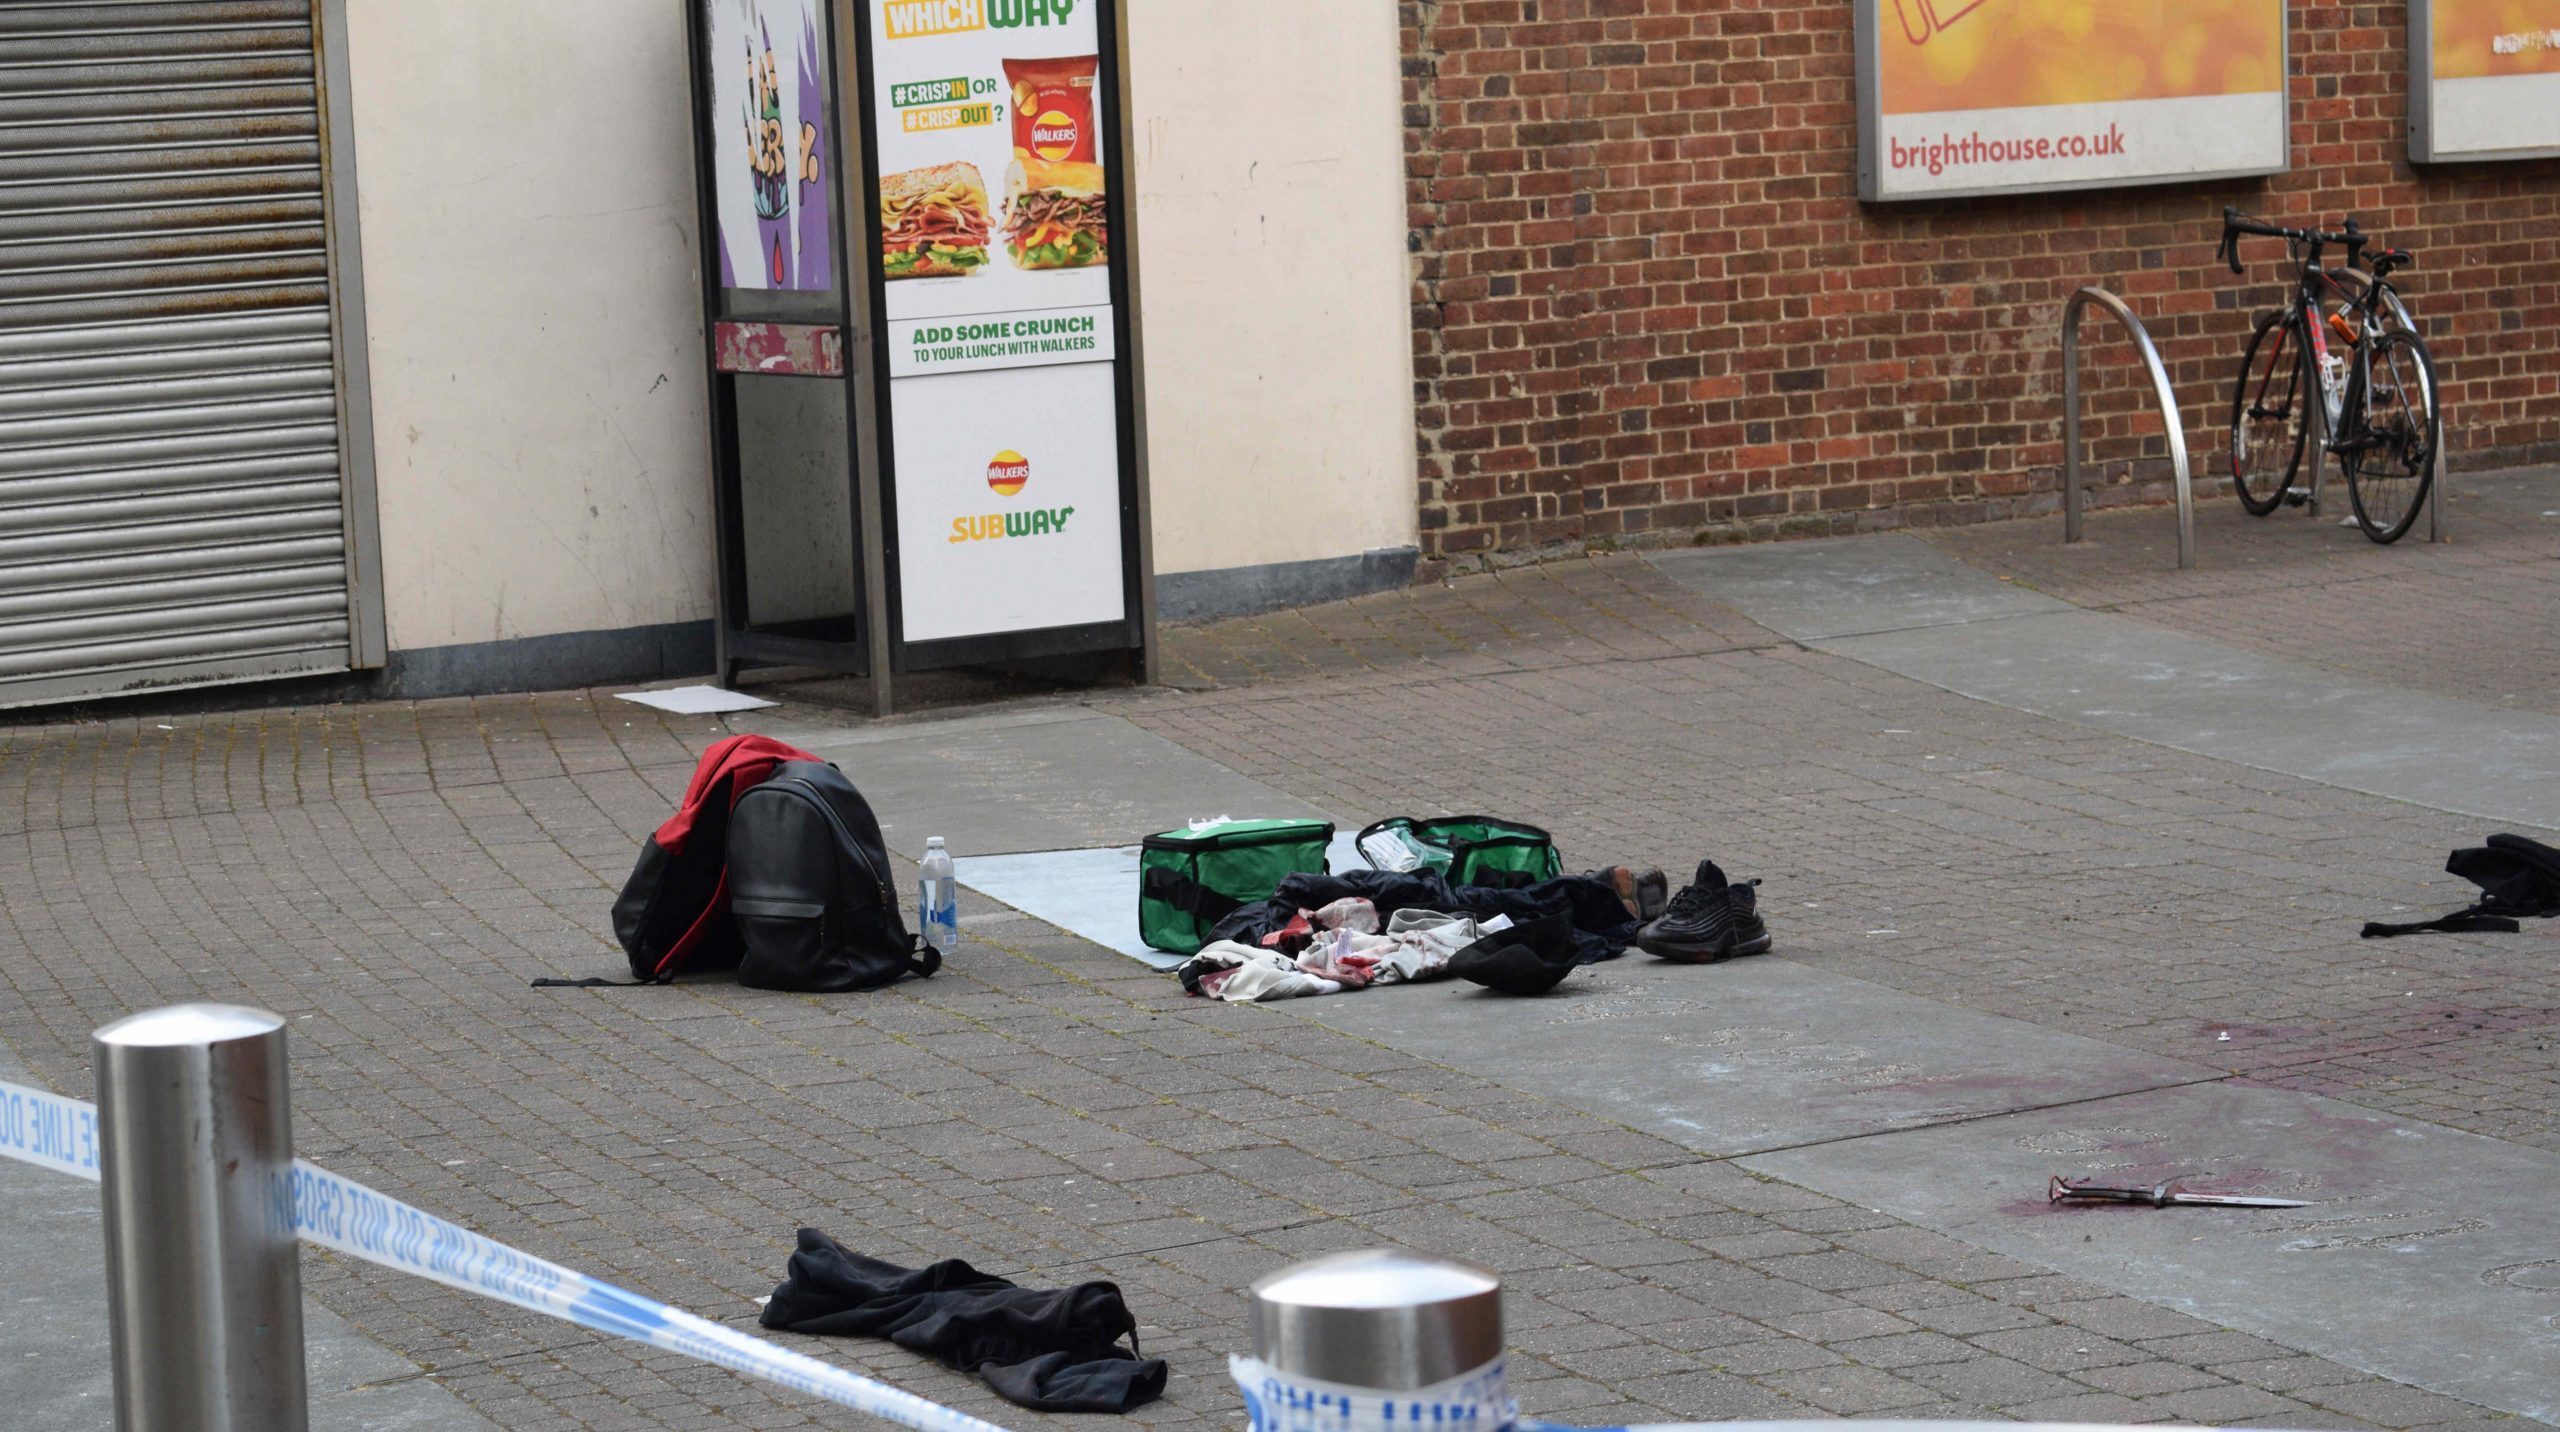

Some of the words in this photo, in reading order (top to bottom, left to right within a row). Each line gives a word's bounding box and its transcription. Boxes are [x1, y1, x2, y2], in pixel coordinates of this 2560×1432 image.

[889, 0, 979, 34] WHICH
[988, 0, 1074, 28] WAY
[894, 80, 967, 105] #CRISPIN
[972, 79, 997, 94] OR
[906, 105, 988, 129] #CRISPOUT
[1033, 128, 1076, 142] WALKERS
[1891, 122, 2125, 176] brighthouse.co.uk
[913, 328, 953, 344] ADD
[957, 322, 1010, 341] SOME
[1014, 316, 1094, 337] CRUNCH
[914, 350, 929, 362] TO
[932, 346, 964, 361] YOUR
[966, 343, 1005, 358] LUNCH
[1008, 340, 1038, 355] WITH
[1040, 336, 1095, 352] WALKERS
[988, 466, 1028, 479] WALKERS
[948, 505, 1075, 544] SUBWAY
